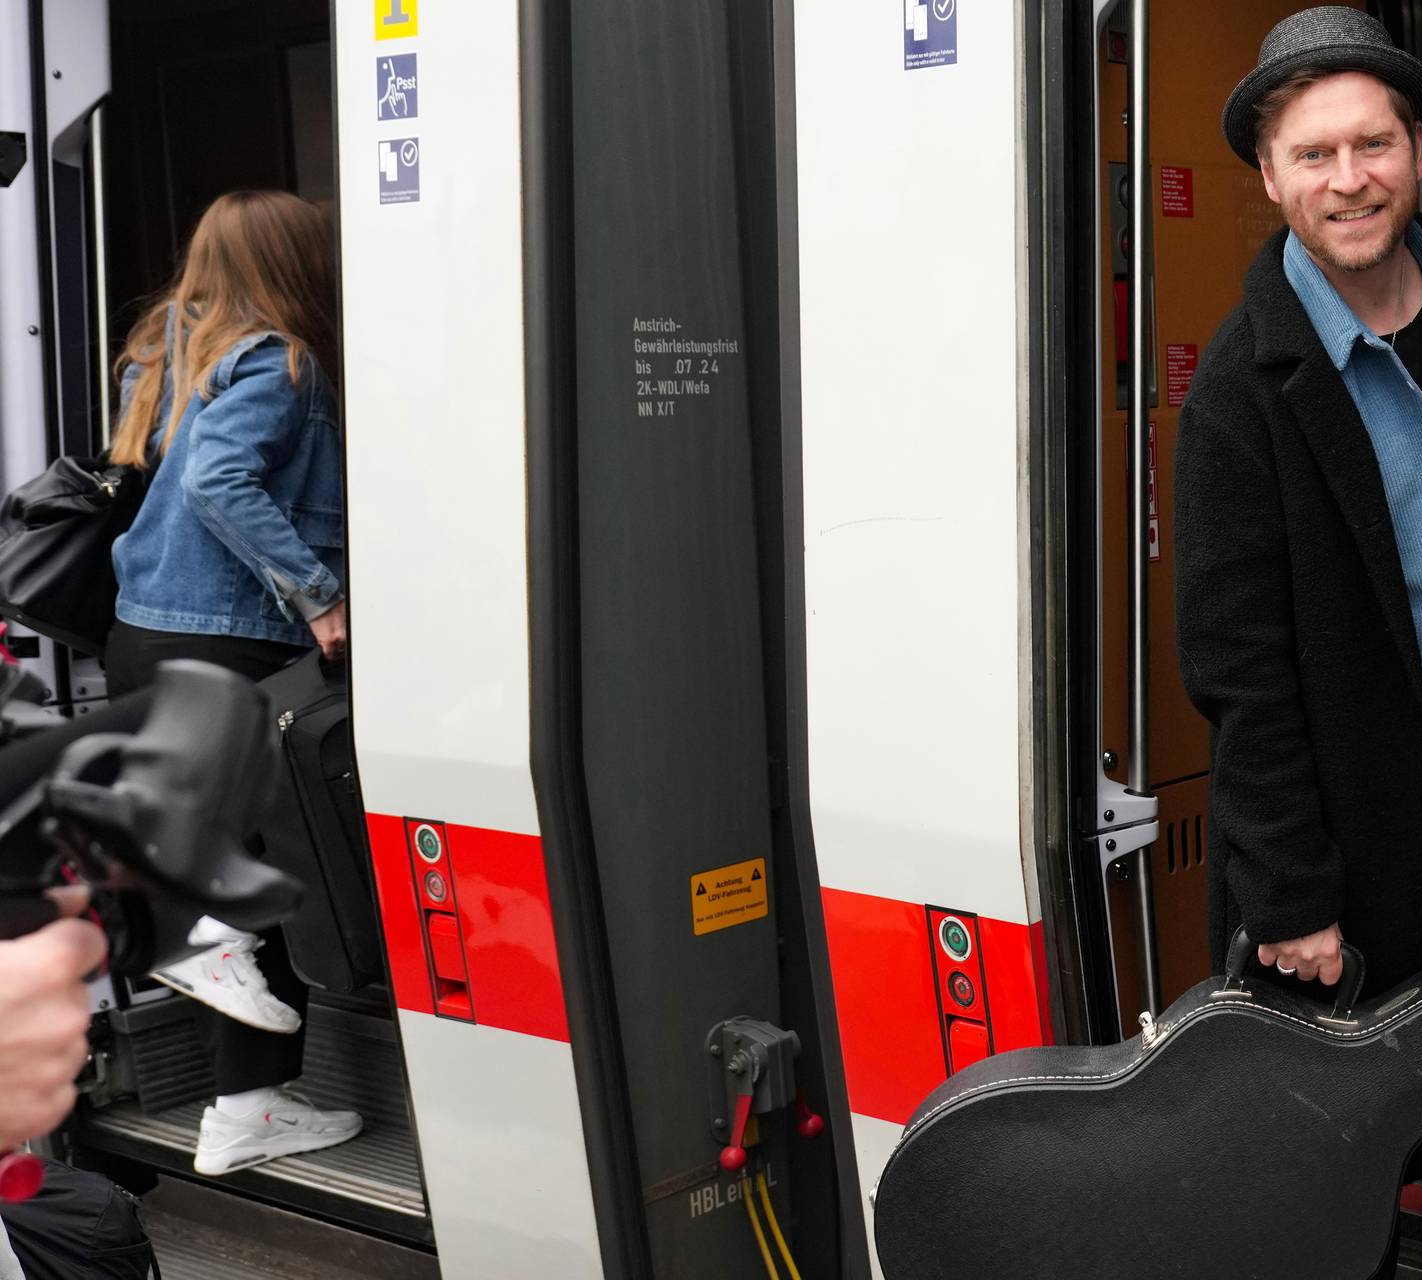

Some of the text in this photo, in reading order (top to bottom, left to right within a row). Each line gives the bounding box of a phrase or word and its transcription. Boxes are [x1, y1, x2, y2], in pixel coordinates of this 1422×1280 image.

[396, 76, 416, 90] Psst
[633, 317, 682, 333] Anstrich-
[634, 338, 739, 357] Gewährleistungsfrist
[635, 359, 652, 374] bis
[638, 401, 675, 416] NN X/T
[690, 1183, 725, 1218] HBL
